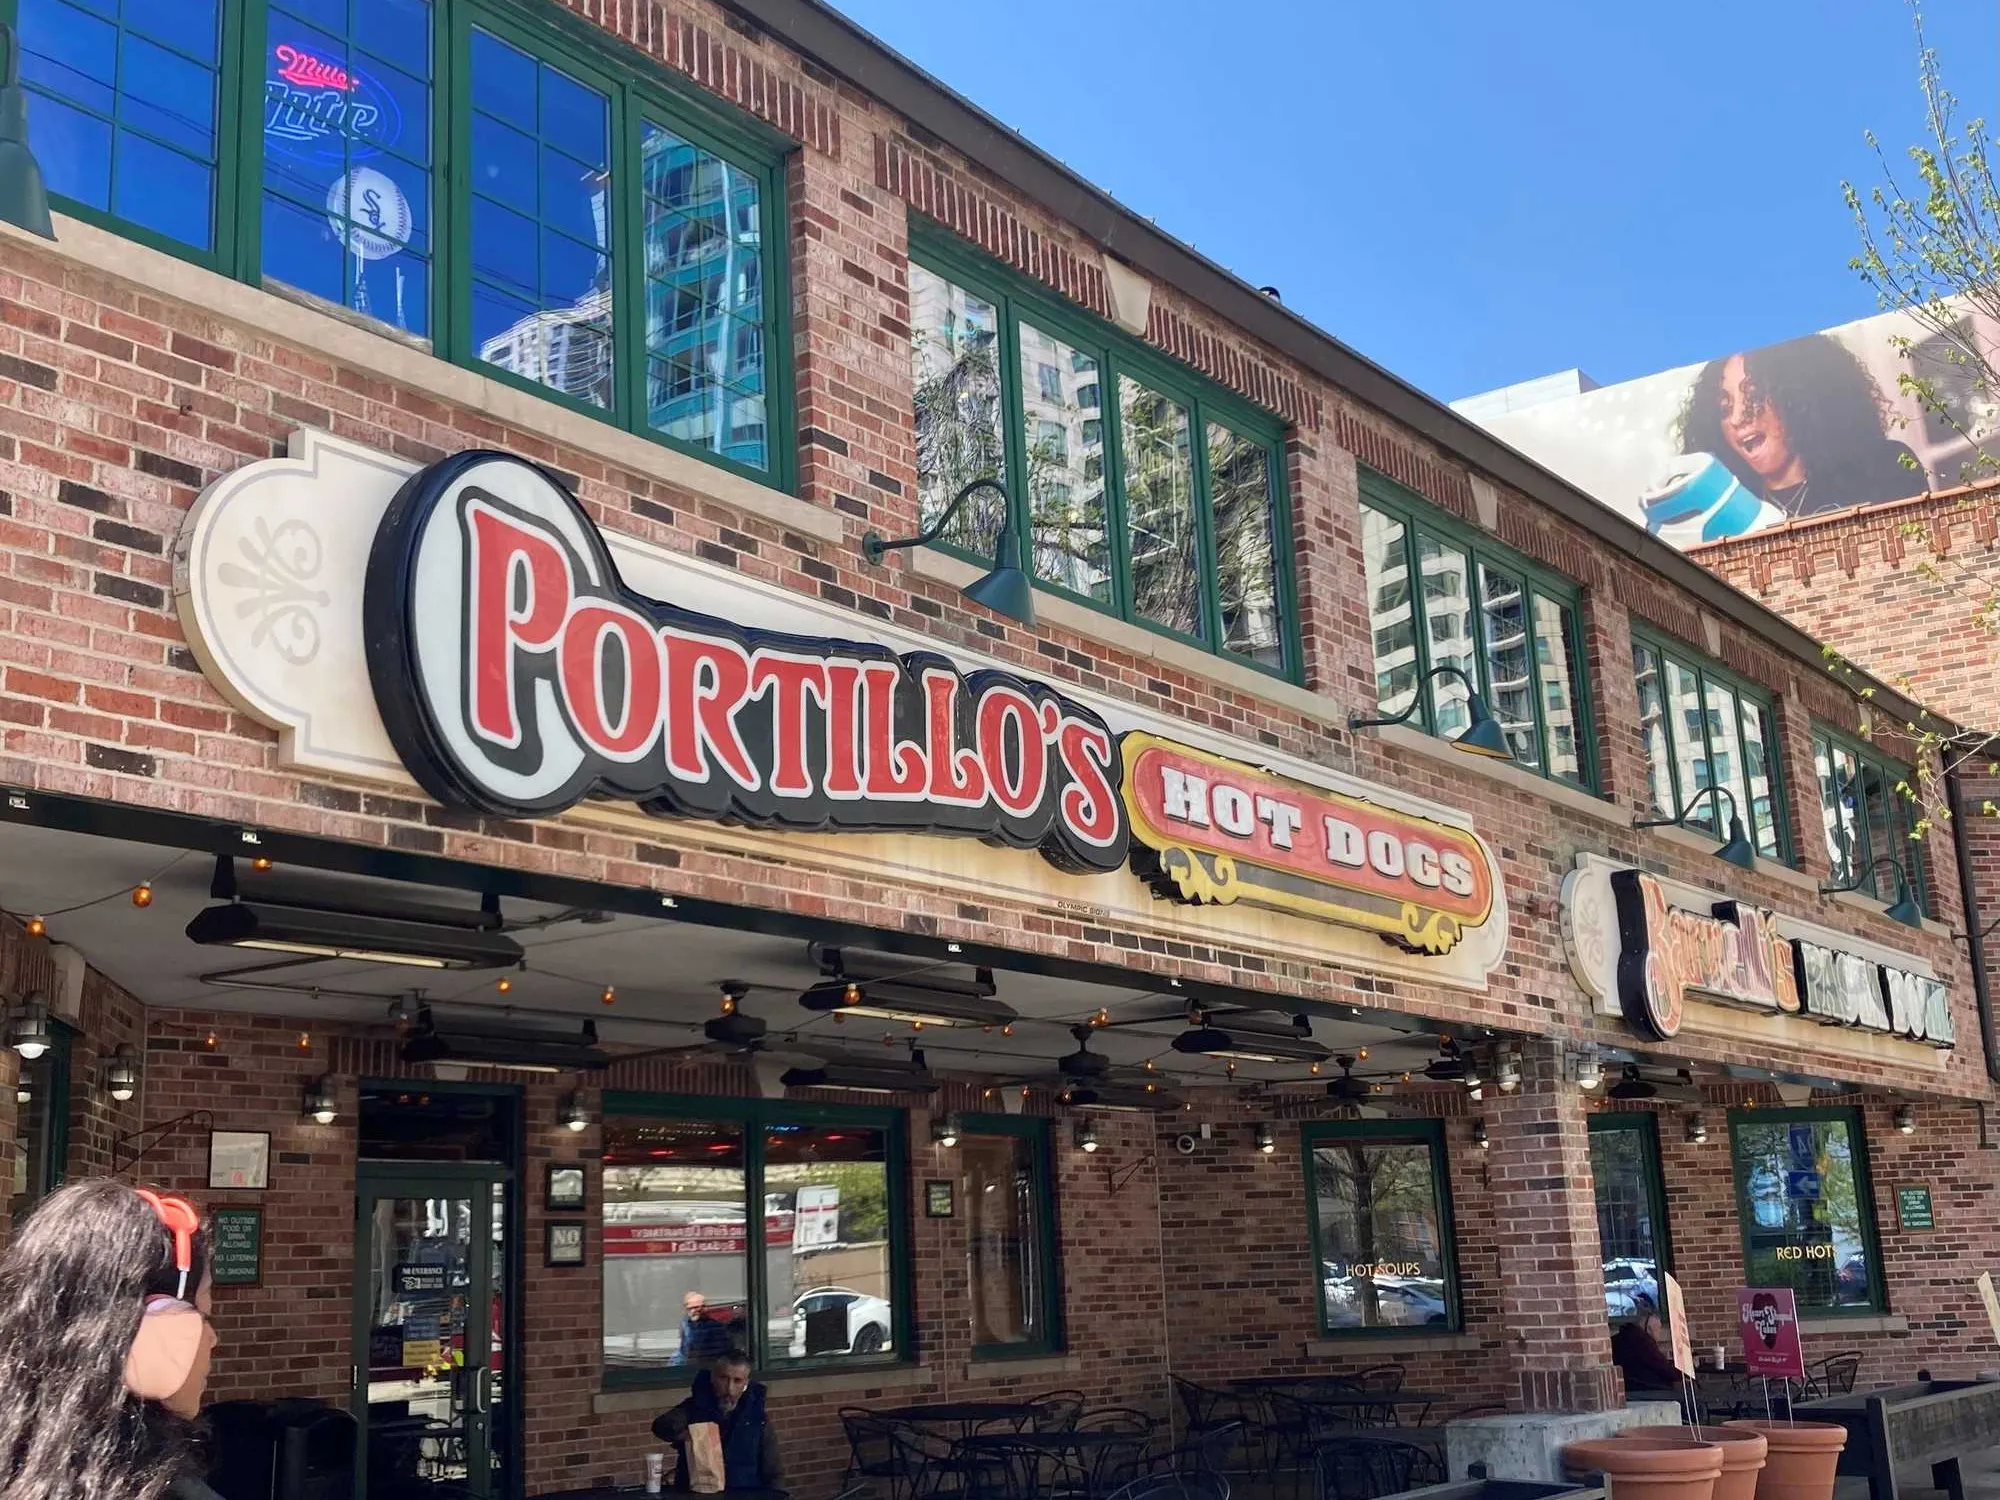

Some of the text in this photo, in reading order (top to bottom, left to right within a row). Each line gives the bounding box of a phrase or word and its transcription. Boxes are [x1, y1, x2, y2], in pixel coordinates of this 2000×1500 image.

[468, 499, 1119, 848] PORTILLO'S
[1161, 765, 1473, 895] HOT DOGS
[553, 1230, 580, 1245] NO
[1776, 1246, 1802, 1260] RED
[1346, 1262, 1420, 1277] HOT SOUPS
